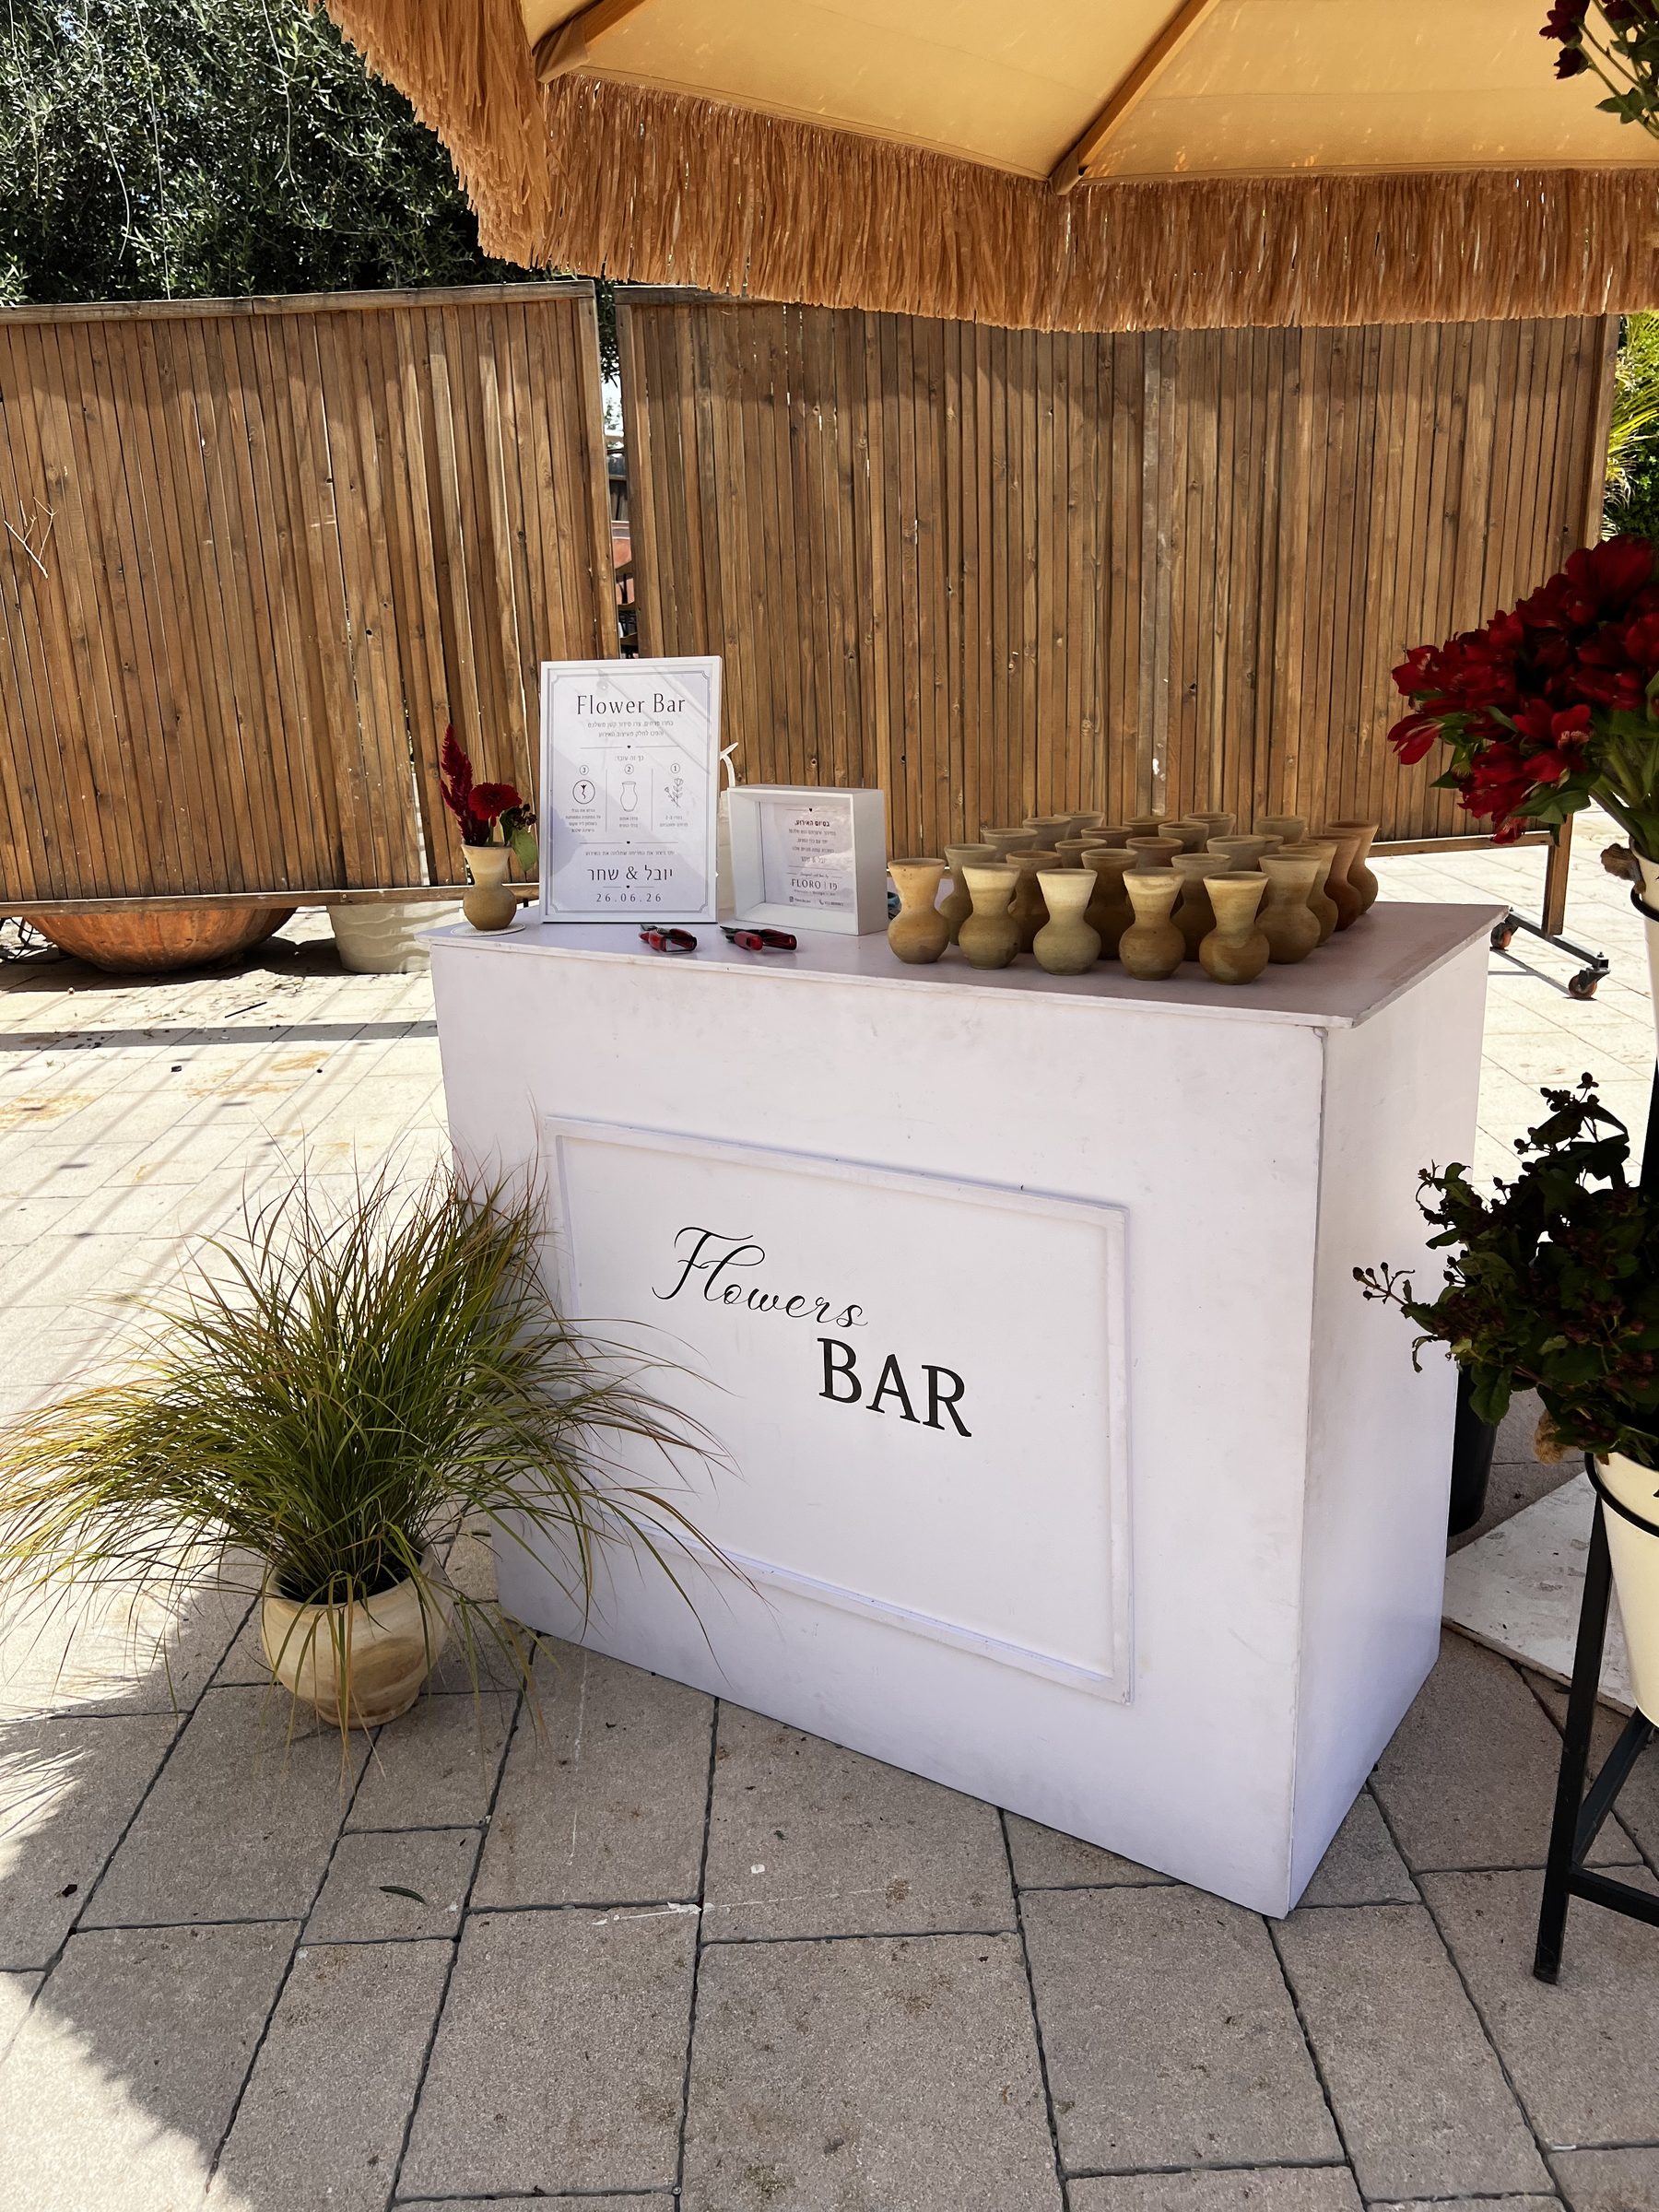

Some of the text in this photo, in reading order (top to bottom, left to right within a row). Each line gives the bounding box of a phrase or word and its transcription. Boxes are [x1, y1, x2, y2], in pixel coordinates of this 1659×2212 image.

[577, 693, 686, 715] Flower Bar
[587, 865, 673, 881] יובל & שחר
[792, 878, 821, 889] FLORO
[596, 893, 662, 902] 26.06.26
[652, 1227, 868, 1328] Flowers
[817, 1337, 972, 1438] BAR
